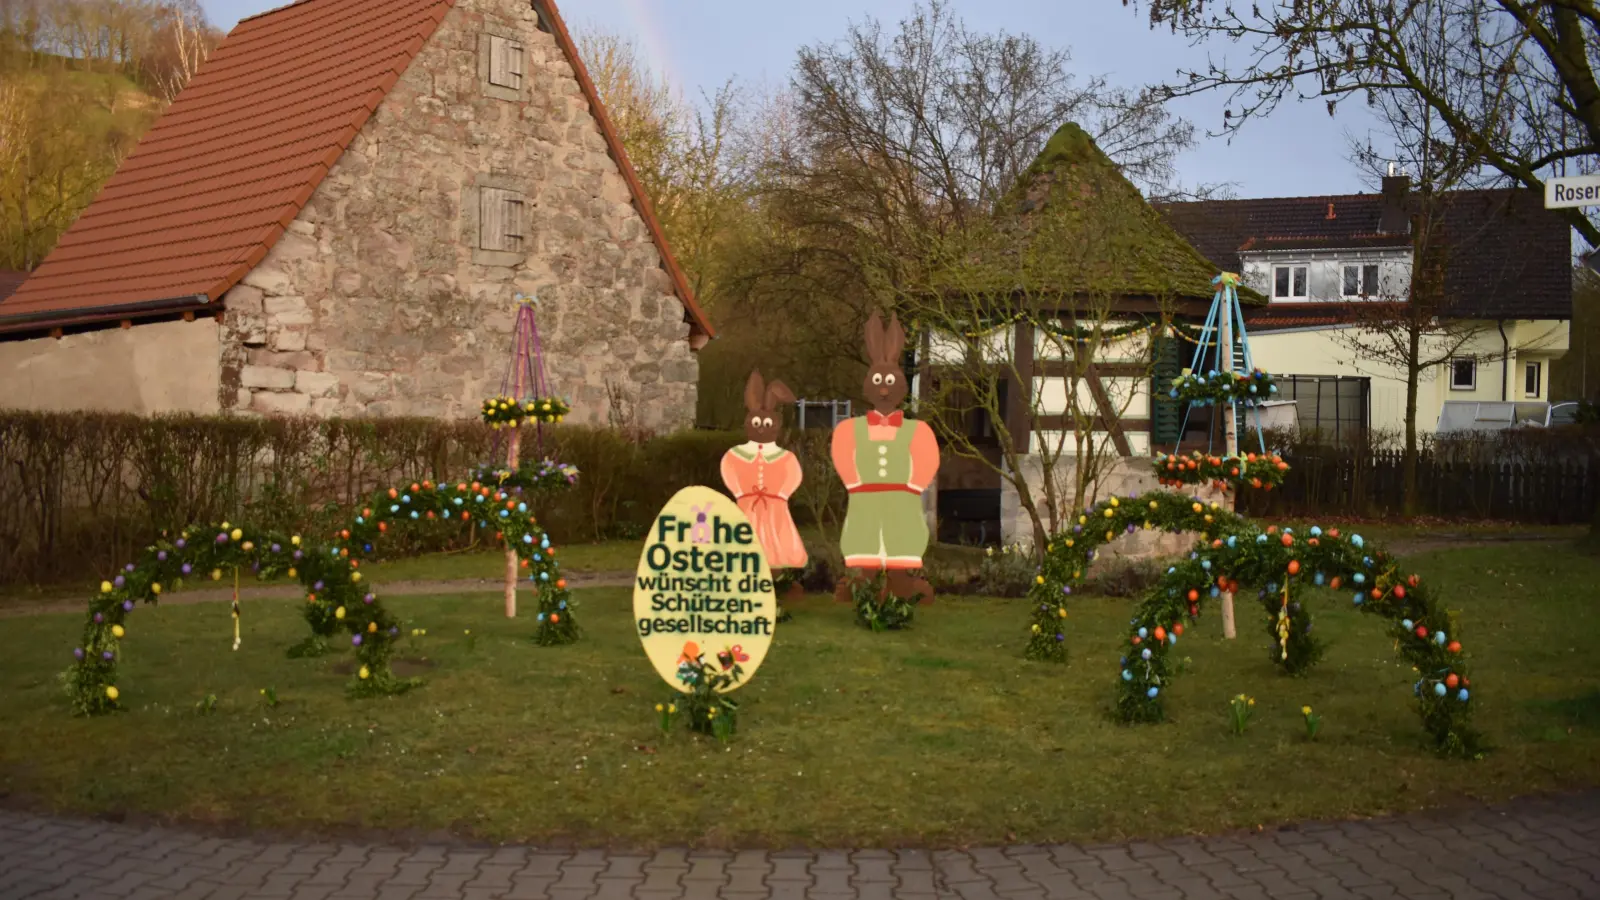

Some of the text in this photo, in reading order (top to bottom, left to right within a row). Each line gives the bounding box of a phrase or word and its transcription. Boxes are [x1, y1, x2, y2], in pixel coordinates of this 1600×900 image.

[658, 508, 753, 544] Frohe
[647, 543, 760, 573] Ostern
[638, 573, 773, 593] wünscht die
[651, 593, 763, 613] Schützen-
[638, 615, 771, 637] gesellschaft
